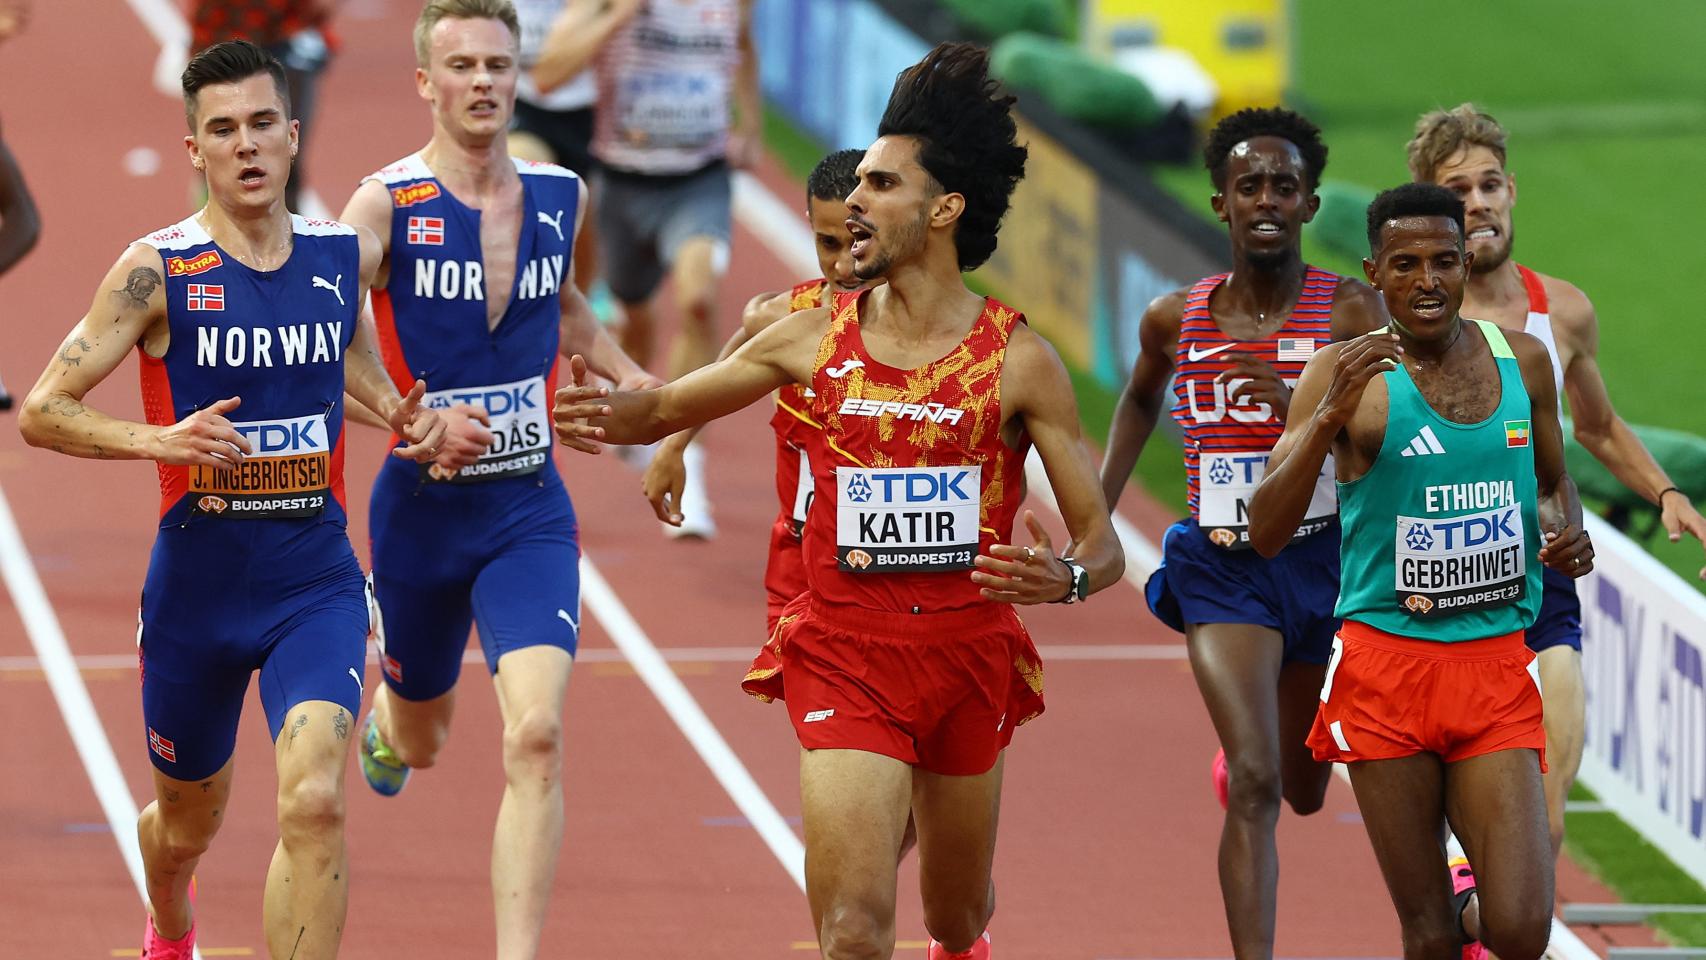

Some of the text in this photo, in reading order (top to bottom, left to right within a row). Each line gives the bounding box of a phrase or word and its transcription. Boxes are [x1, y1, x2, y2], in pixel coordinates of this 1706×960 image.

[197, 321, 343, 368] NORWAY
[452, 383, 536, 417] TDK
[838, 398, 965, 426] ESPAÑA
[1186, 378, 1299, 423] US
[193, 455, 326, 491] J. INGEBRIGTSEN
[460, 458, 530, 477] BUDAPEST
[871, 470, 970, 503] TDK
[1425, 480, 1515, 513] ETHIOPIA
[231, 495, 324, 512] BUDAPEST 23
[859, 511, 956, 544] KATIR
[1433, 509, 1517, 551] TDK
[877, 550, 971, 566] BUDAPEST 23
[1402, 544, 1520, 589] GEBRHIWET
[1438, 584, 1520, 609] BUDAPEST 23
[802, 708, 835, 723] ESP
